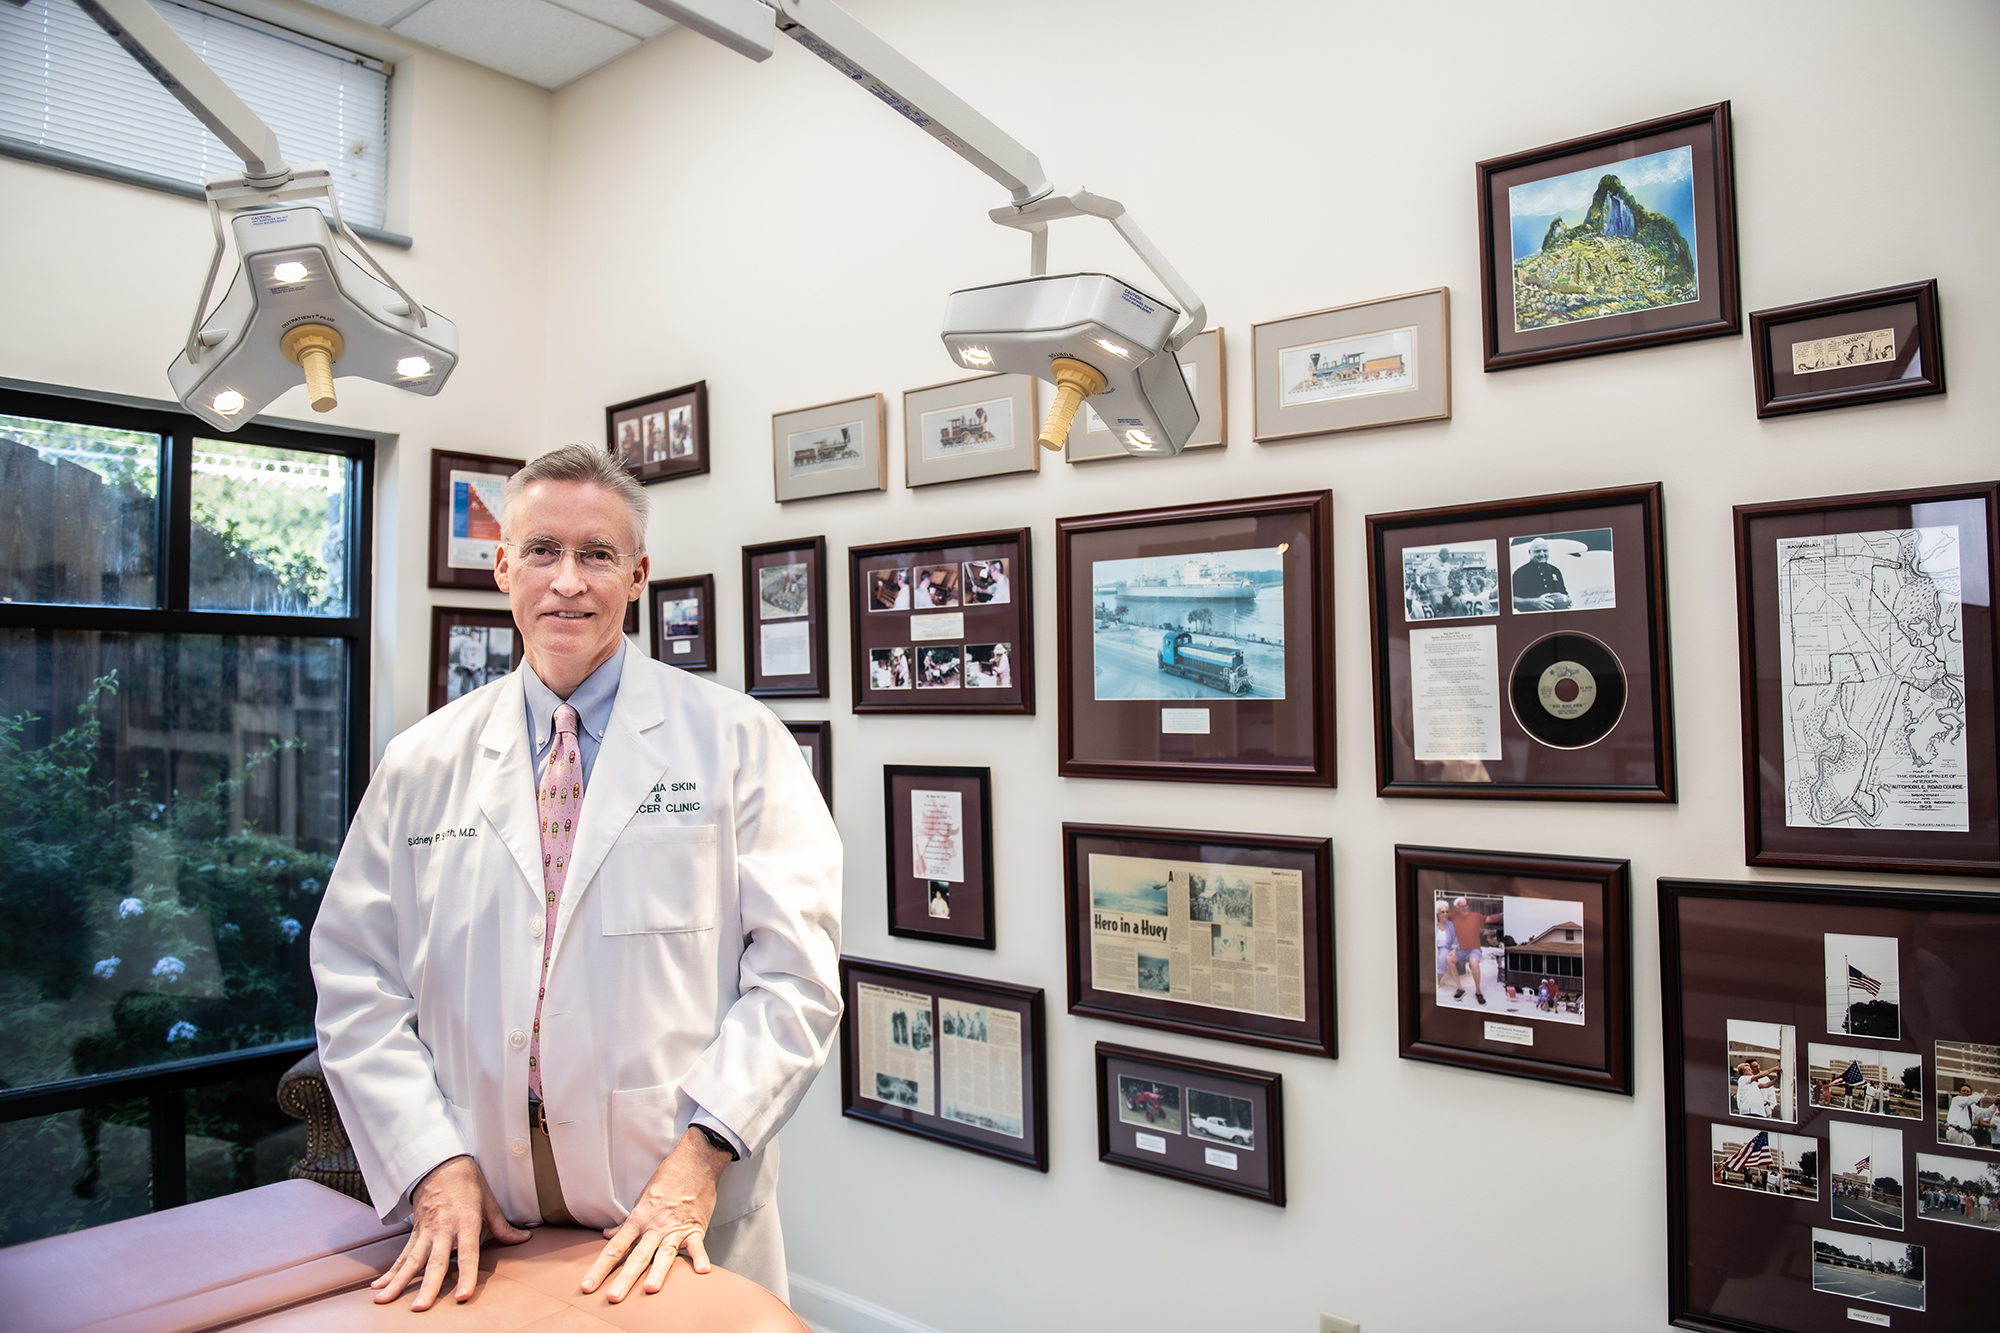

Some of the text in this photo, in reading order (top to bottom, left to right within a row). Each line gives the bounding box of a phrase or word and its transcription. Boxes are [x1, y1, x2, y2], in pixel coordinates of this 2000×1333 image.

[1466, 600, 1483, 616] 36
[671, 782, 696, 791] SKIN
[654, 794, 661, 802] &
[636, 802, 700, 813] CER CLINIC
[408, 836, 433, 846] Sidney
[459, 828, 478, 837] M.D.
[1168, 871, 1174, 883] A
[1094, 914, 1168, 941] Hero in a Huey
